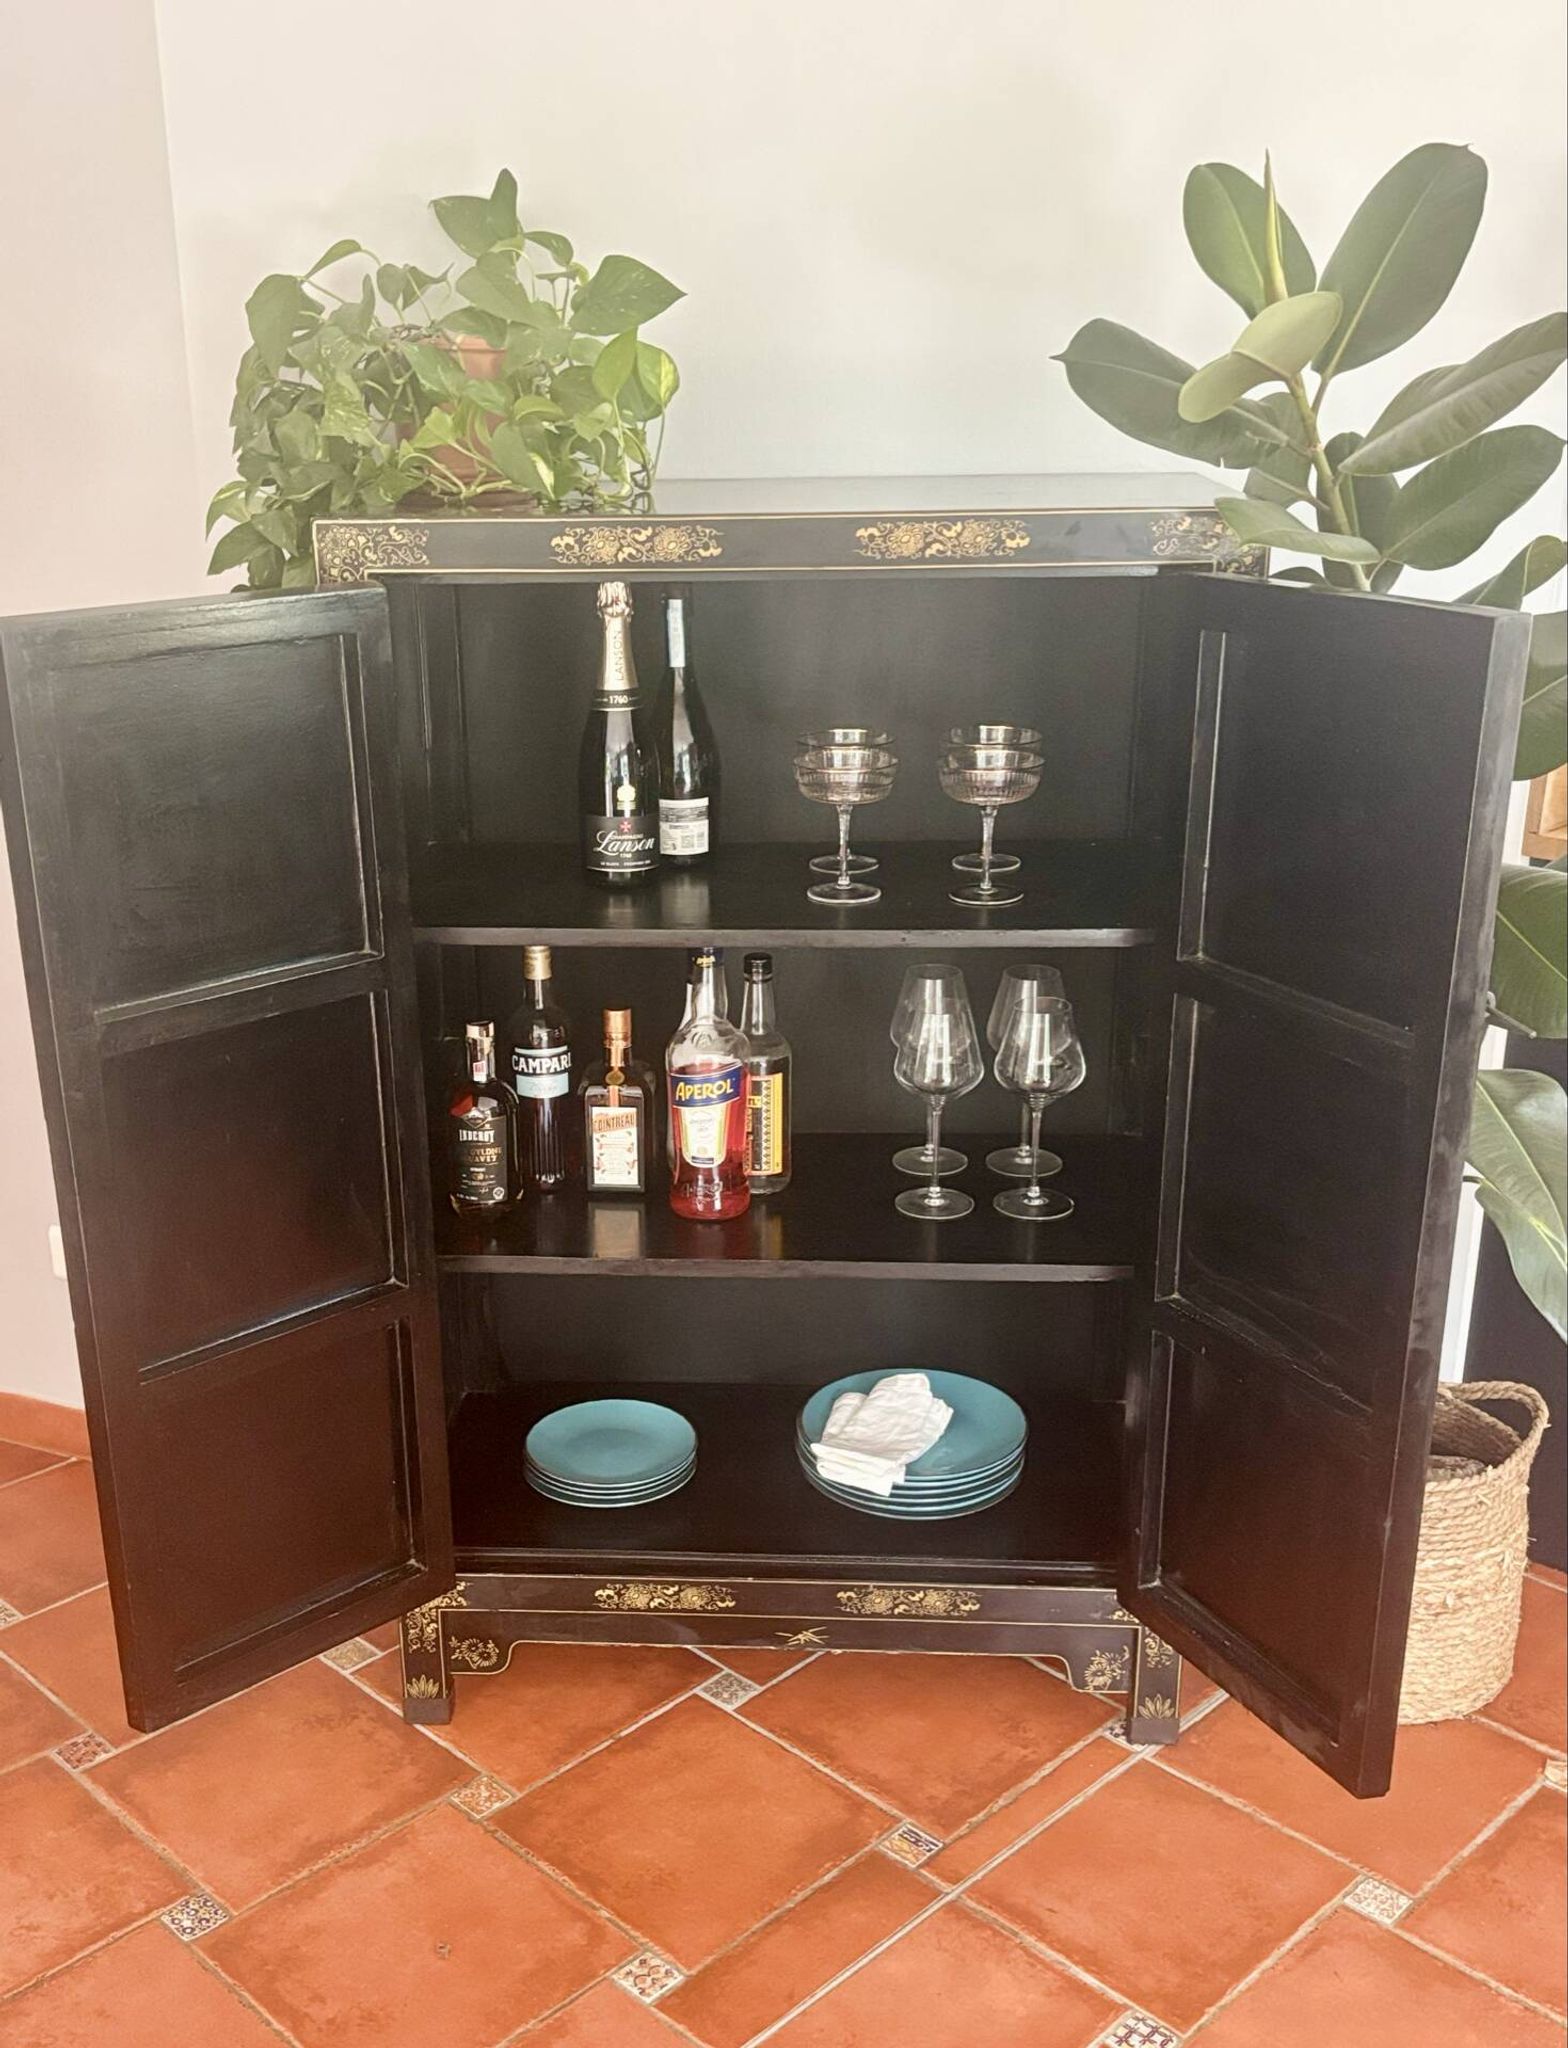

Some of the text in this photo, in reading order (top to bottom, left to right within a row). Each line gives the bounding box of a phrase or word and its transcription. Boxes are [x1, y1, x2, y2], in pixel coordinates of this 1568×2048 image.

[613, 630, 625, 681] LANSON
[608, 695, 629, 705] 1760
[595, 830, 655, 856] Lanson
[511, 1052, 572, 1074] CAMPARI
[675, 1078, 734, 1101] APEROL
